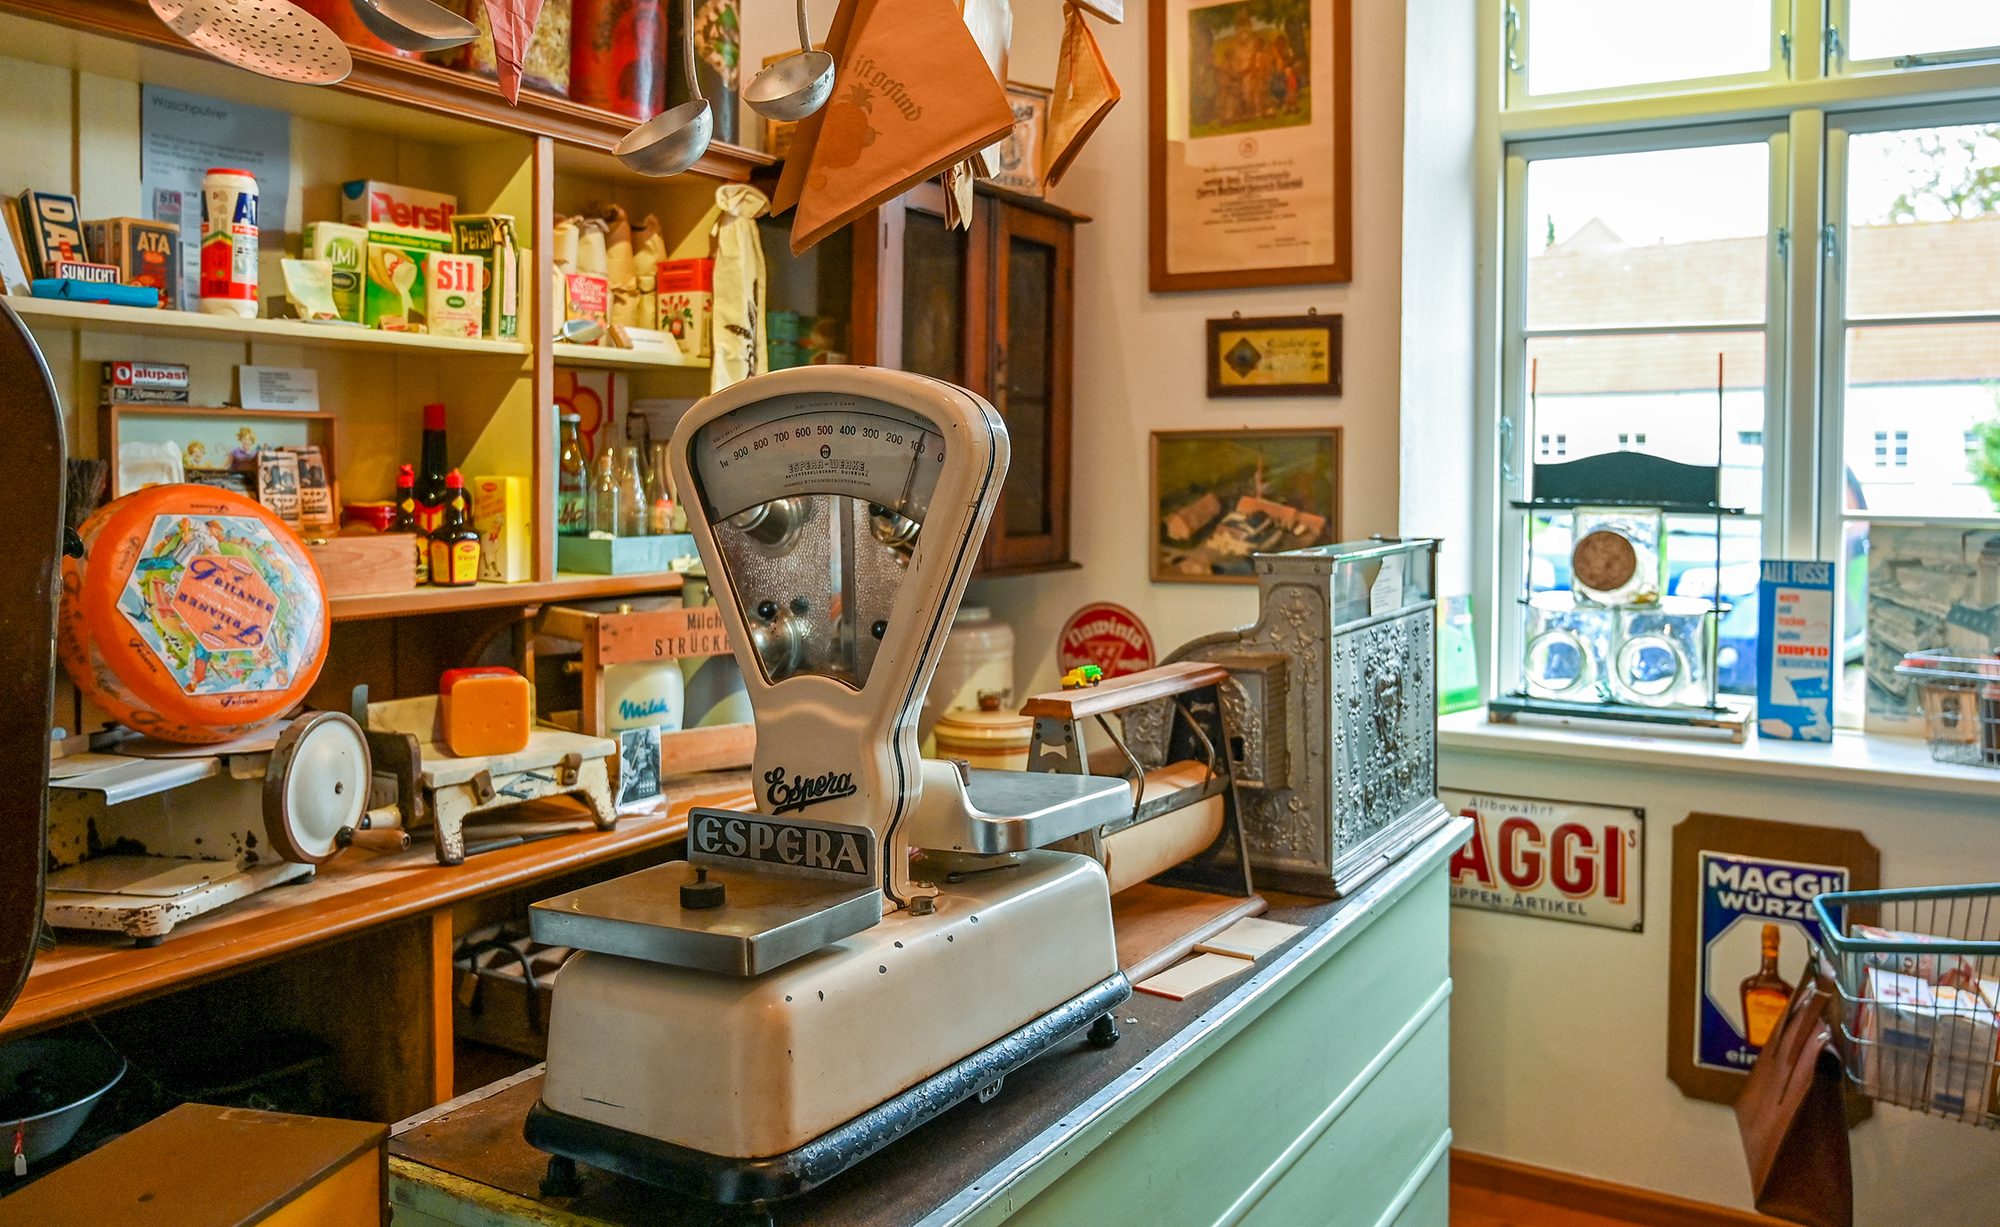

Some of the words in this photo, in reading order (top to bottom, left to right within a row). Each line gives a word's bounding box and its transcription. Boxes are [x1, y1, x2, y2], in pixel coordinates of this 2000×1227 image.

[150, 95, 228, 120] Waschpulver
[137, 231, 171, 255] ATA
[460, 224, 493, 252] Persil
[61, 264, 116, 283] SUNLICHT
[437, 260, 475, 293] Sil
[733, 446, 749, 460] 900
[753, 437, 769, 451] 800
[774, 431, 790, 443] 700
[795, 426, 811, 438] 600
[817, 424, 833, 436] 500
[839, 425, 856, 436] 400
[862, 427, 880, 439] 300
[886, 432, 903, 445] 200
[910, 440, 926, 454] 100
[937, 452, 944, 463] 0
[687, 613, 723, 630] Milch
[764, 766, 857, 815] Espera
[696, 816, 867, 874] ESPERA
